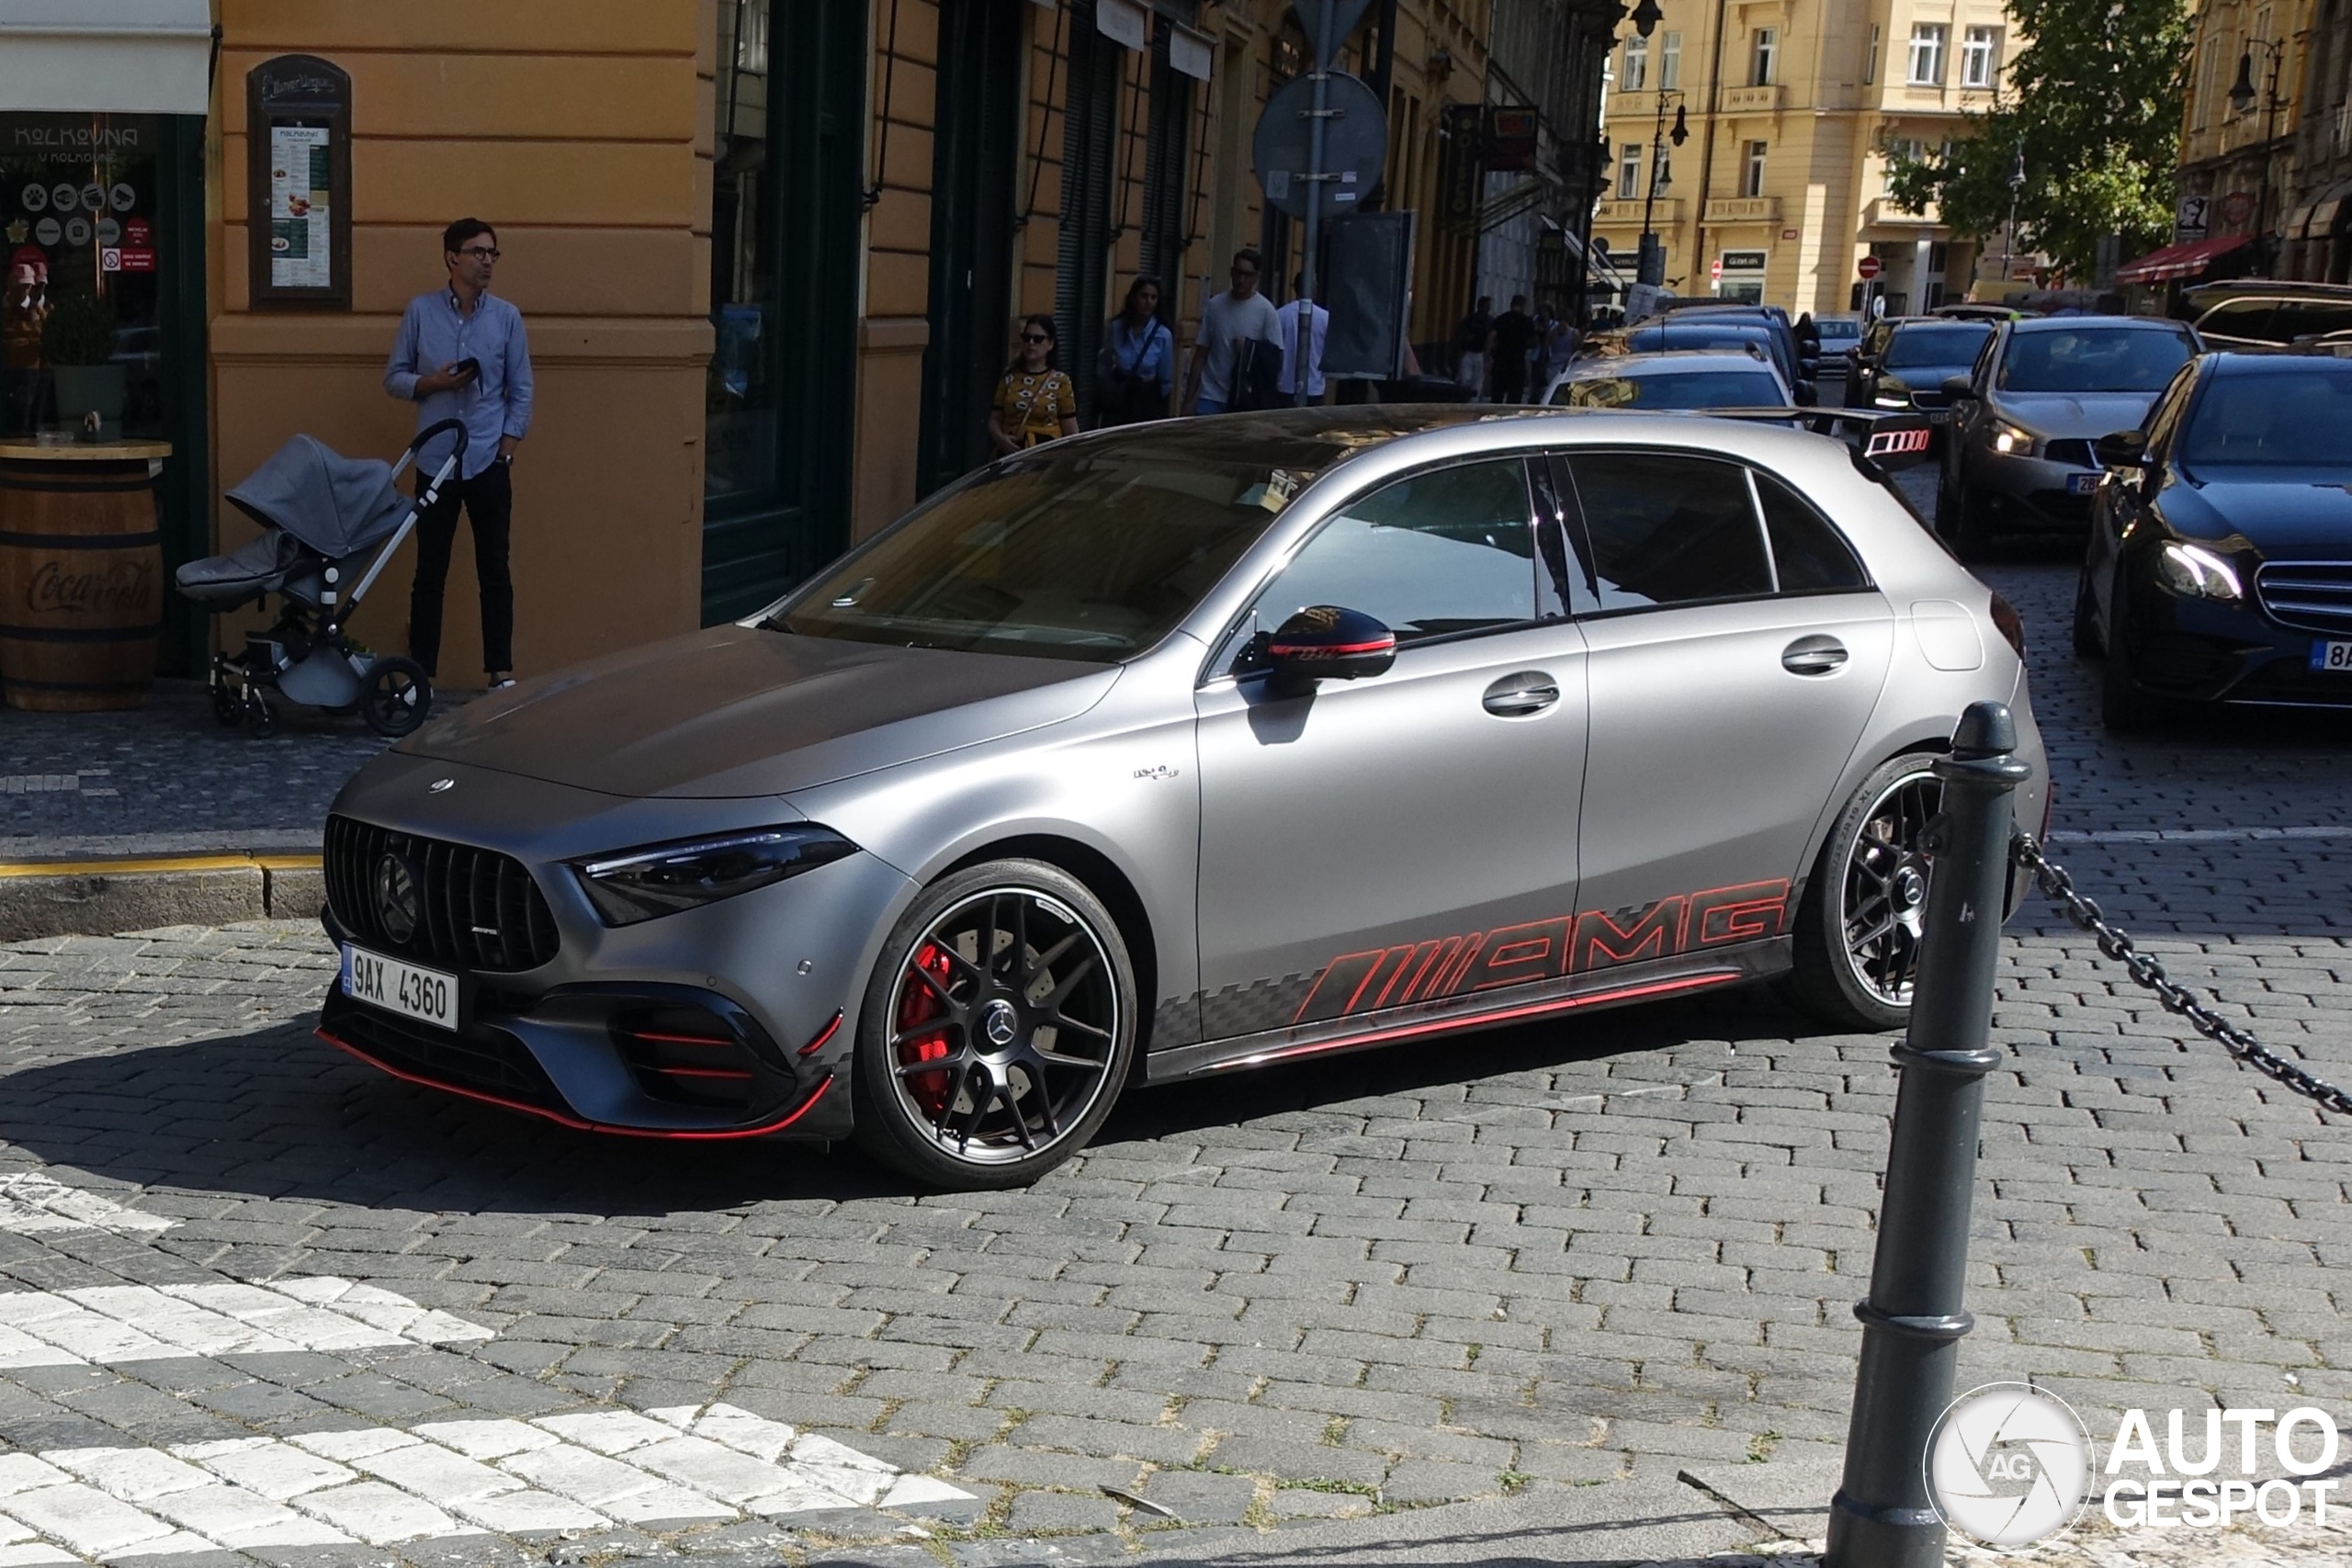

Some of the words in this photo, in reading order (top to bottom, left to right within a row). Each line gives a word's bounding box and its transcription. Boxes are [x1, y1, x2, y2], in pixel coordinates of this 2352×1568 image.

[15, 128, 138, 146] KOLKOVNA
[2080, 478, 2099, 491] 2B
[355, 953, 385, 1002] 9AX
[399, 969, 447, 1020] 4360
